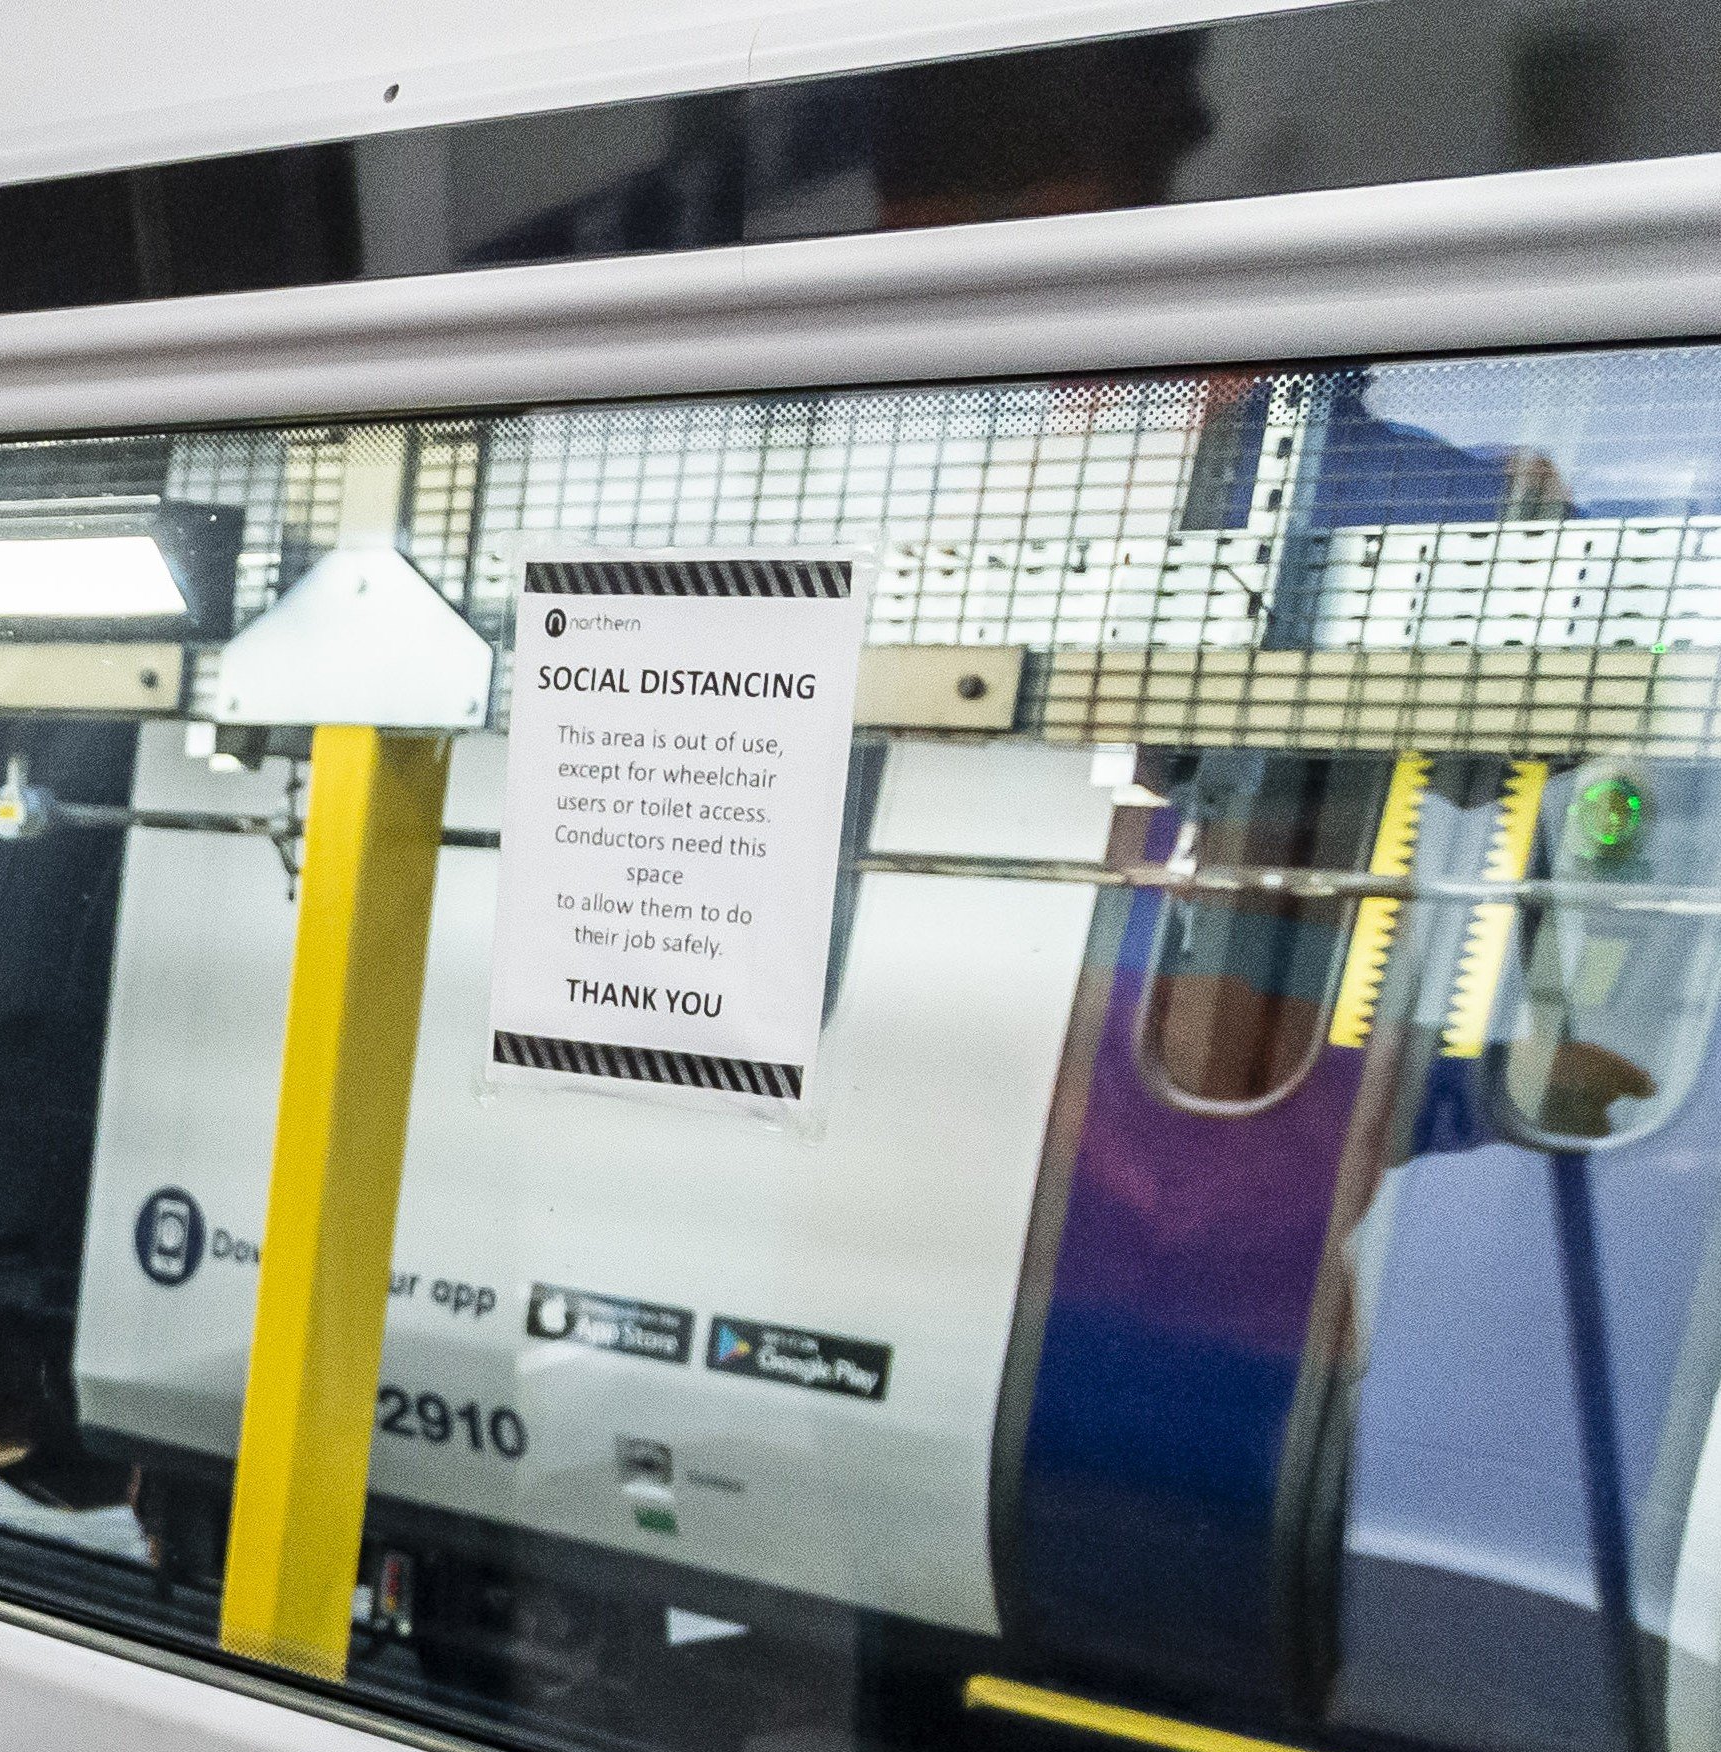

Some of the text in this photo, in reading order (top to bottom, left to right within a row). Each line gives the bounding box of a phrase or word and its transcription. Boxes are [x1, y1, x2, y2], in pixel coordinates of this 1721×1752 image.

[569, 613, 641, 632] northern
[538, 666, 817, 700] SOCIAL DISTANCING
[558, 725, 784, 757] This area is out of use,
[558, 761, 778, 788] except for wheelchair
[557, 795, 772, 823] users or toilet access.
[555, 824, 767, 858] Conductors need this
[626, 865, 684, 886] space
[557, 892, 753, 925] to allow them to do
[574, 925, 723, 959] their job safely.
[565, 979, 723, 1018] THANK YOU
[430, 1277, 498, 1320] app
